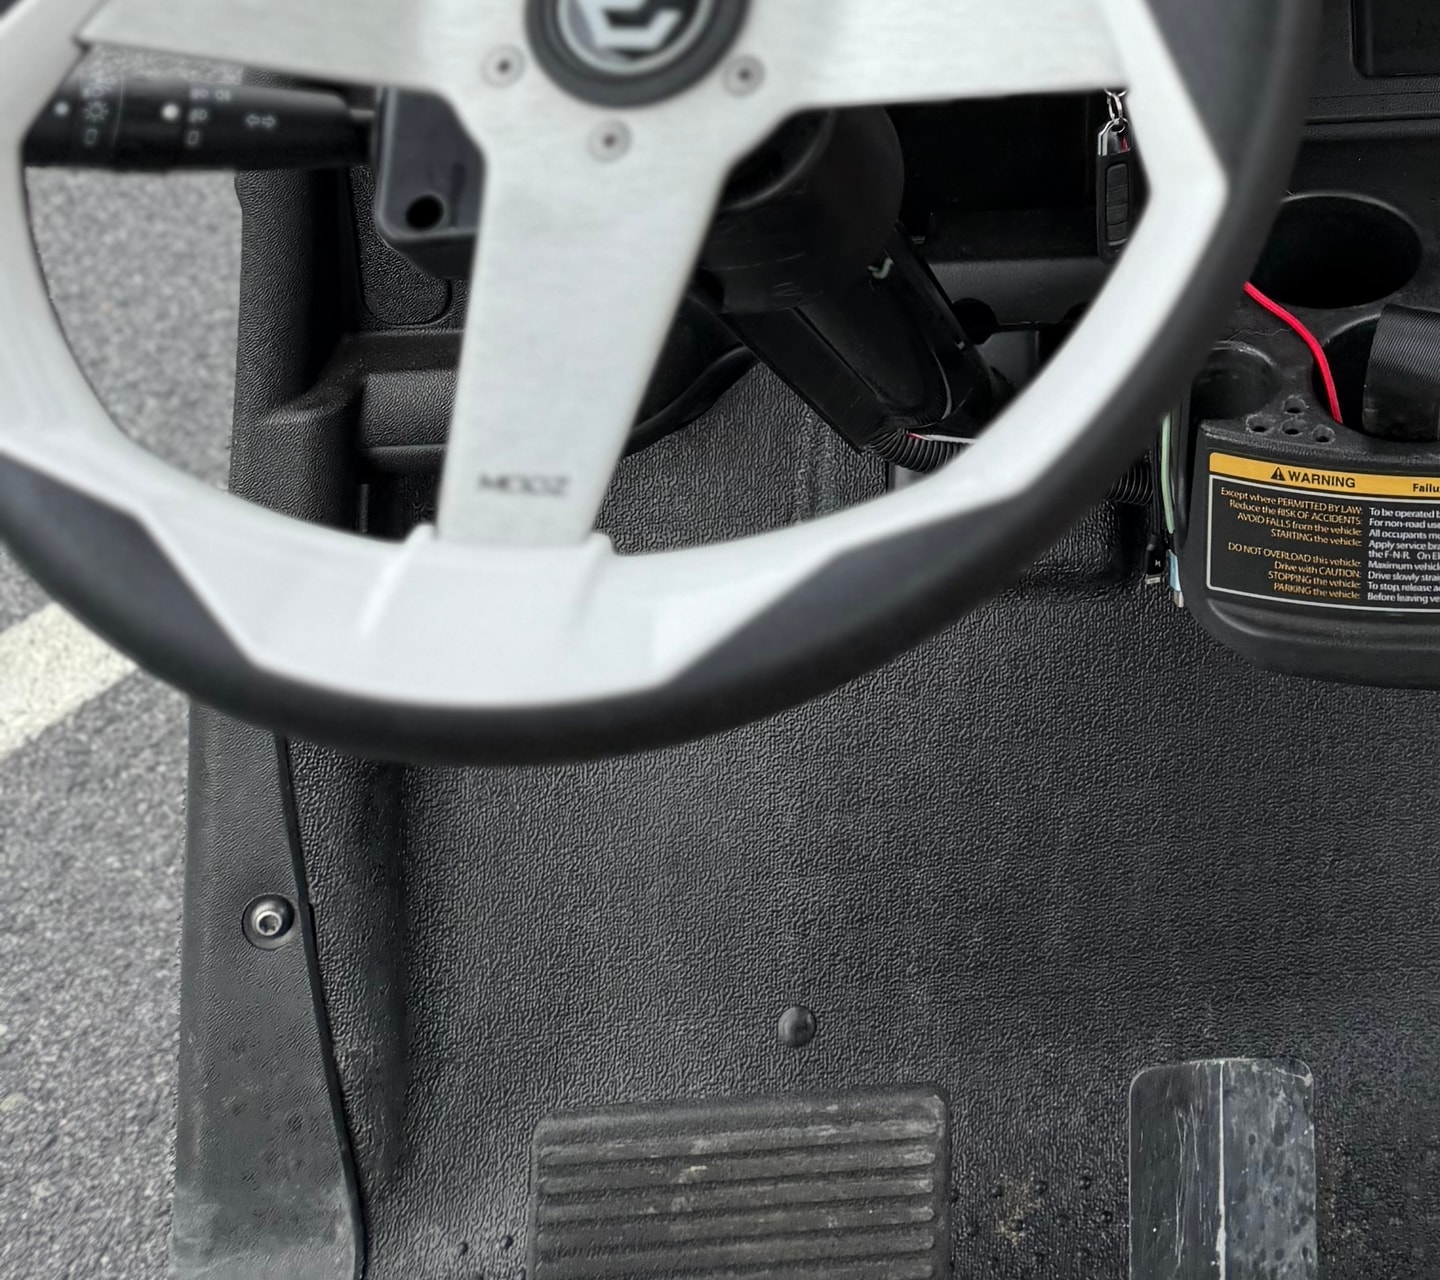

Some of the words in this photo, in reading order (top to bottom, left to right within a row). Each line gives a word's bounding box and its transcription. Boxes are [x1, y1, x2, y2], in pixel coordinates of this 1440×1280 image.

[1288, 470, 1356, 488] WARNING
[1221, 488, 1248, 501] Except
[1250, 494, 1276, 504] where
[1278, 497, 1326, 511] PERMITTED
[1328, 504, 1340, 512] BY
[1230, 500, 1260, 512] Reduce
[1278, 508, 1295, 518] RISK
[1298, 511, 1309, 520] OF
[1369, 508, 1380, 516] To
[1395, 510, 1434, 519] operated
[1238, 513, 1264, 524] AVOID
[1266, 517, 1290, 528] FALLS
[1292, 521, 1313, 531] from
[1370, 519, 1383, 527] For
[1271, 529, 1313, 542] STARTING
[1369, 529, 1380, 538] All
[1382, 531, 1427, 540] occupants
[1369, 540, 1394, 551] Apply
[1396, 541, 1426, 550] service
[1229, 543, 1242, 552] DO
[1244, 545, 1261, 555] NOT
[1264, 548, 1310, 562] OVERLOAD
[1368, 551, 1383, 559] the
[1417, 552, 1431, 560] On
[1275, 561, 1297, 572] Drive
[1299, 565, 1317, 574] with
[1368, 560, 1412, 570] Maximum
[1269, 571, 1311, 584] STOPPING
[1368, 572, 1391, 580] Drive
[1393, 572, 1419, 583] slowly
[1274, 583, 1311, 595] PARKING
[1368, 582, 1378, 590] To
